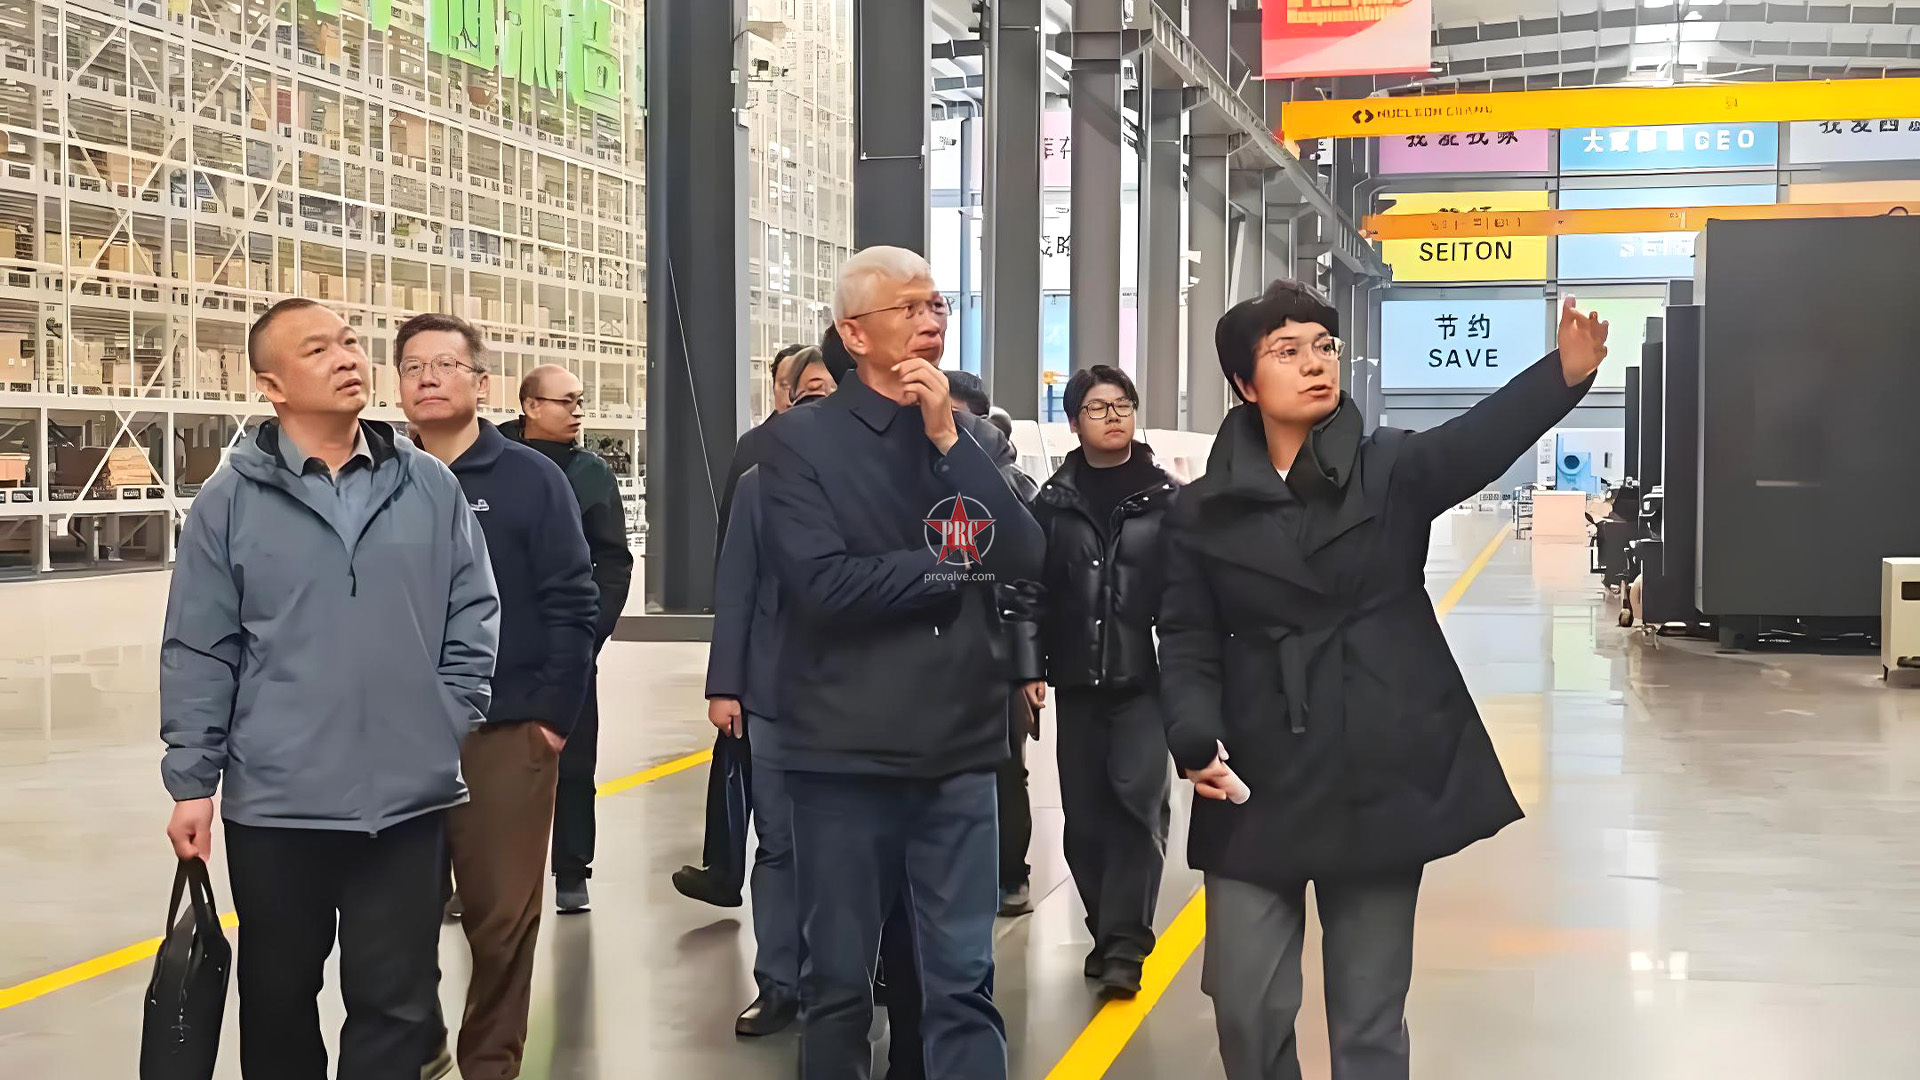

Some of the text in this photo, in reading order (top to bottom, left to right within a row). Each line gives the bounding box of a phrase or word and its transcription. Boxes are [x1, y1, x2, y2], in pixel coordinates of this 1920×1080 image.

[1419, 240, 1513, 262] SEITON
[1434, 313, 1491, 340] 节约
[1428, 348, 1499, 368] SAVE
